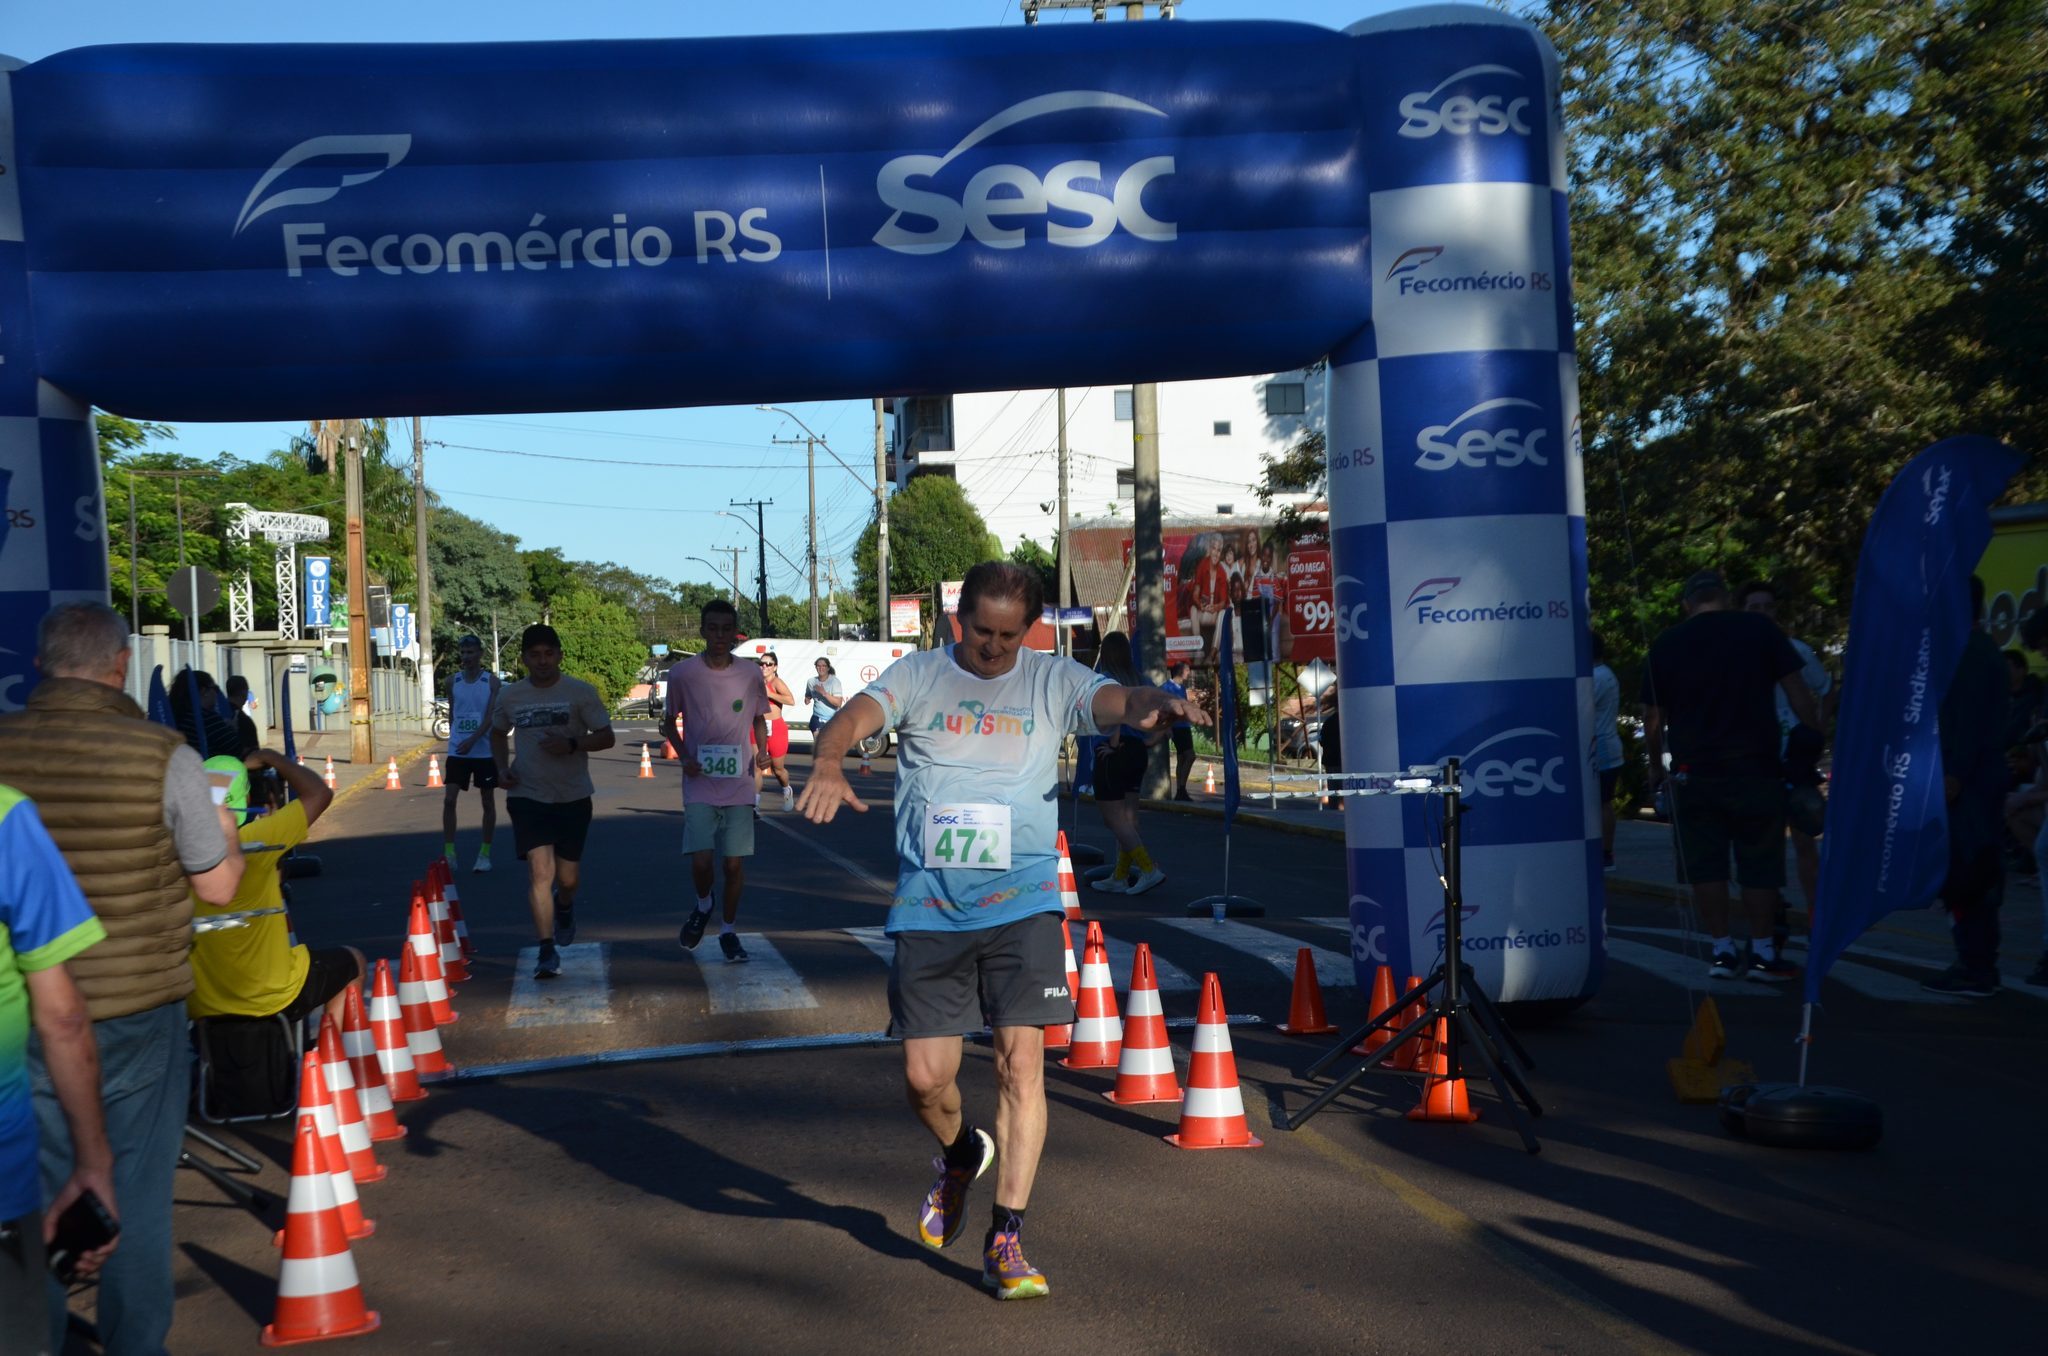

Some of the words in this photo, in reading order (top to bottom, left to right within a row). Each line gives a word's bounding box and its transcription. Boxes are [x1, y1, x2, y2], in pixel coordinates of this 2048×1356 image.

[282, 212, 673, 277] Fecomércio
[693, 207, 783, 265] RS
[1399, 270, 1526, 296] Fecomércio
[1530, 272, 1552, 293] RS
[1353, 447, 1375, 468] RS
[1290, 564, 1304, 574] 600
[1305, 562, 1325, 573] MEGA
[311, 579, 325, 624] URI
[1418, 602, 1543, 625] Fecomércio
[1548, 600, 1570, 619] RS
[396, 618, 405, 649] URI
[1337, 602, 1369, 642] sc
[458, 719, 479, 731] 488
[927, 711, 1036, 737] Autismo
[704, 756, 737, 775] 348
[1892, 751, 1912, 779] RS
[934, 828, 1000, 863] 472
[1566, 926, 1587, 945] RS
[1044, 986, 1069, 998] FILA
